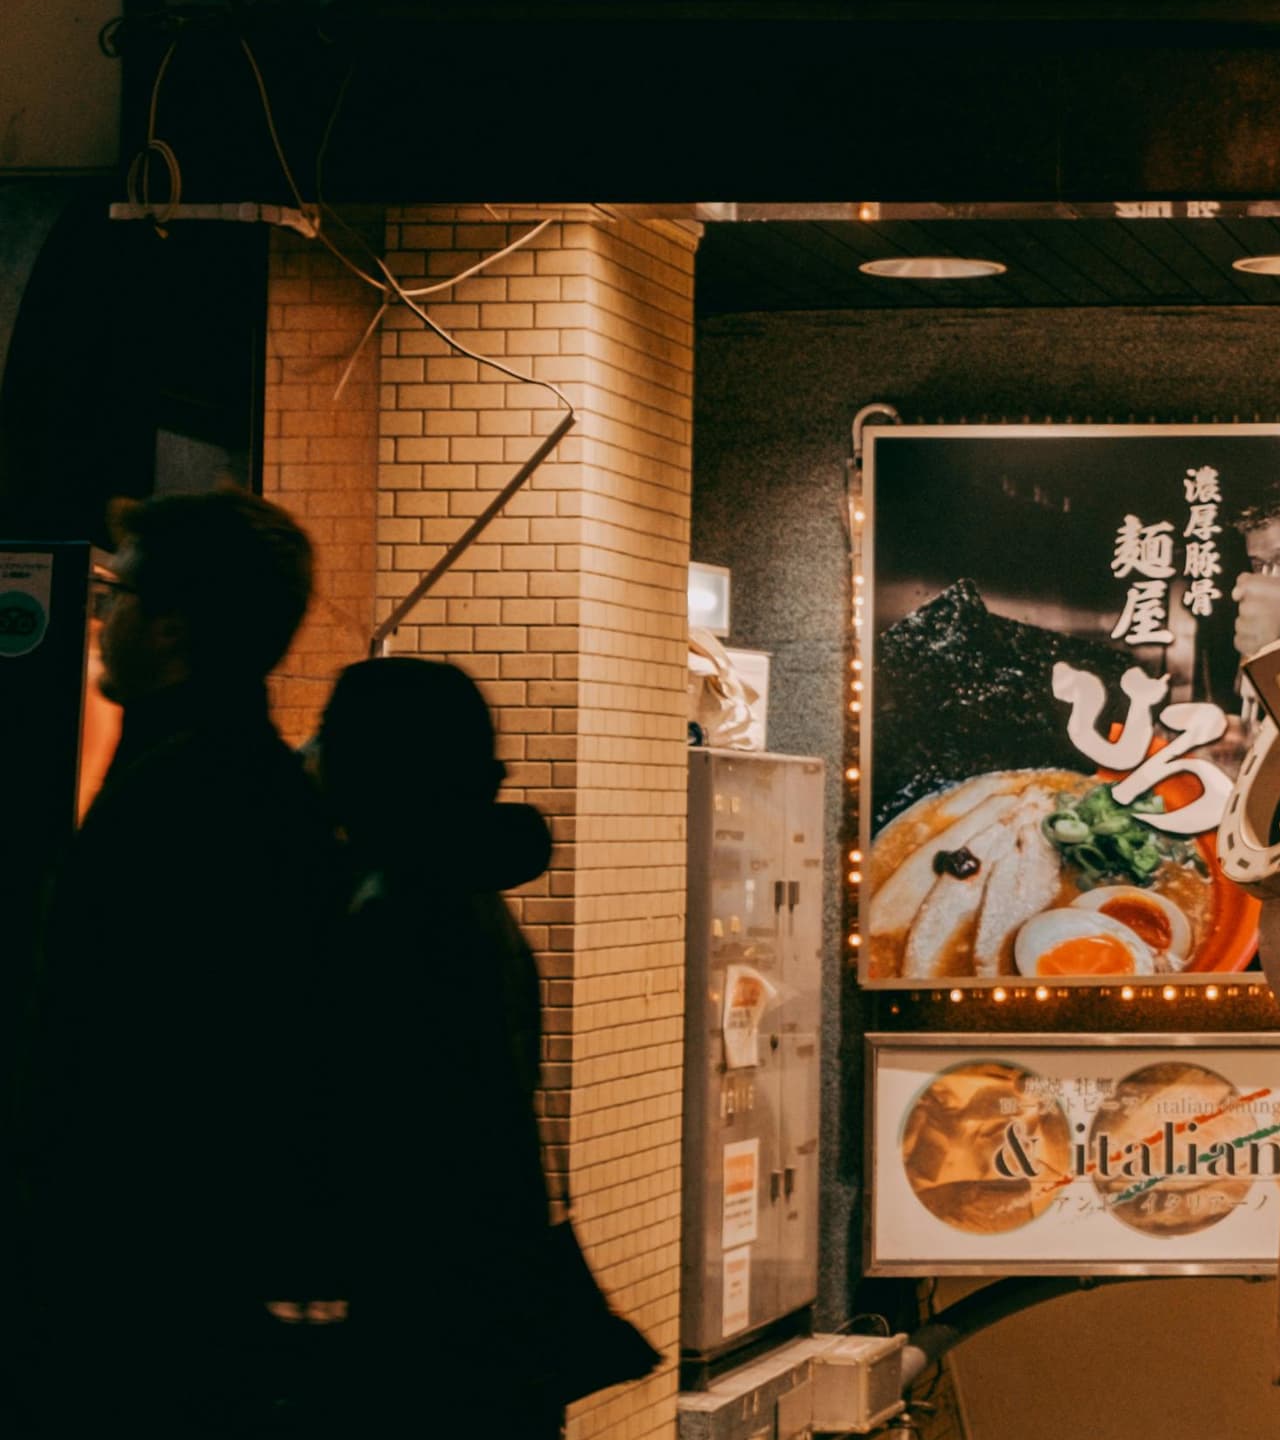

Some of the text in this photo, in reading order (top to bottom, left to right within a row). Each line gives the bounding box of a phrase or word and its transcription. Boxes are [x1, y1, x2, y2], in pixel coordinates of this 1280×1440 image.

[1111, 513, 1175, 646] 麺屋
[1181, 466, 1223, 617] 濃厚豚骨
[1050, 660, 1234, 836] ひろ
[994, 1119, 1041, 1179] &
